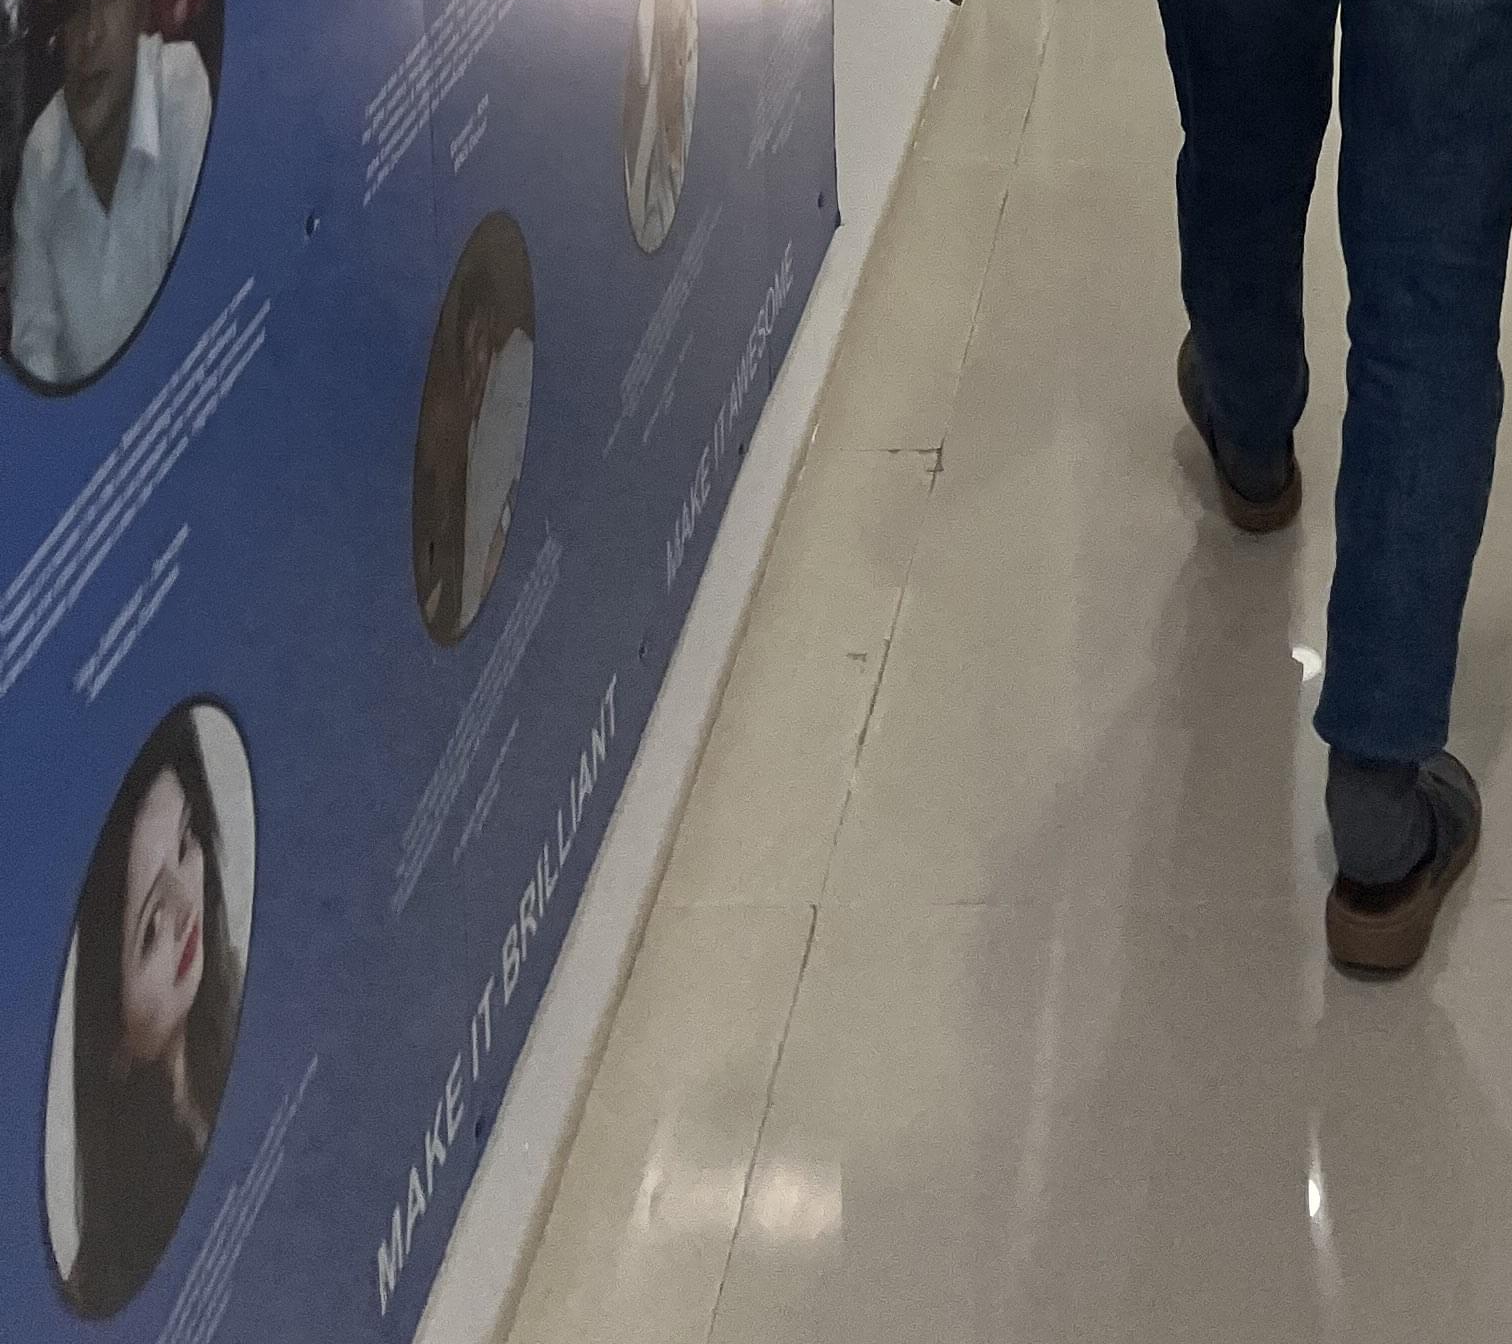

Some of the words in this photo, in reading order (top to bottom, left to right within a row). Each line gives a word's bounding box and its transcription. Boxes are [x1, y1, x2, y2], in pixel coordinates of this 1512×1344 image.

[377, 1052, 465, 1317] MAKE
[471, 976, 496, 1082] IT
[503, 673, 618, 1006] BRILLIANT
